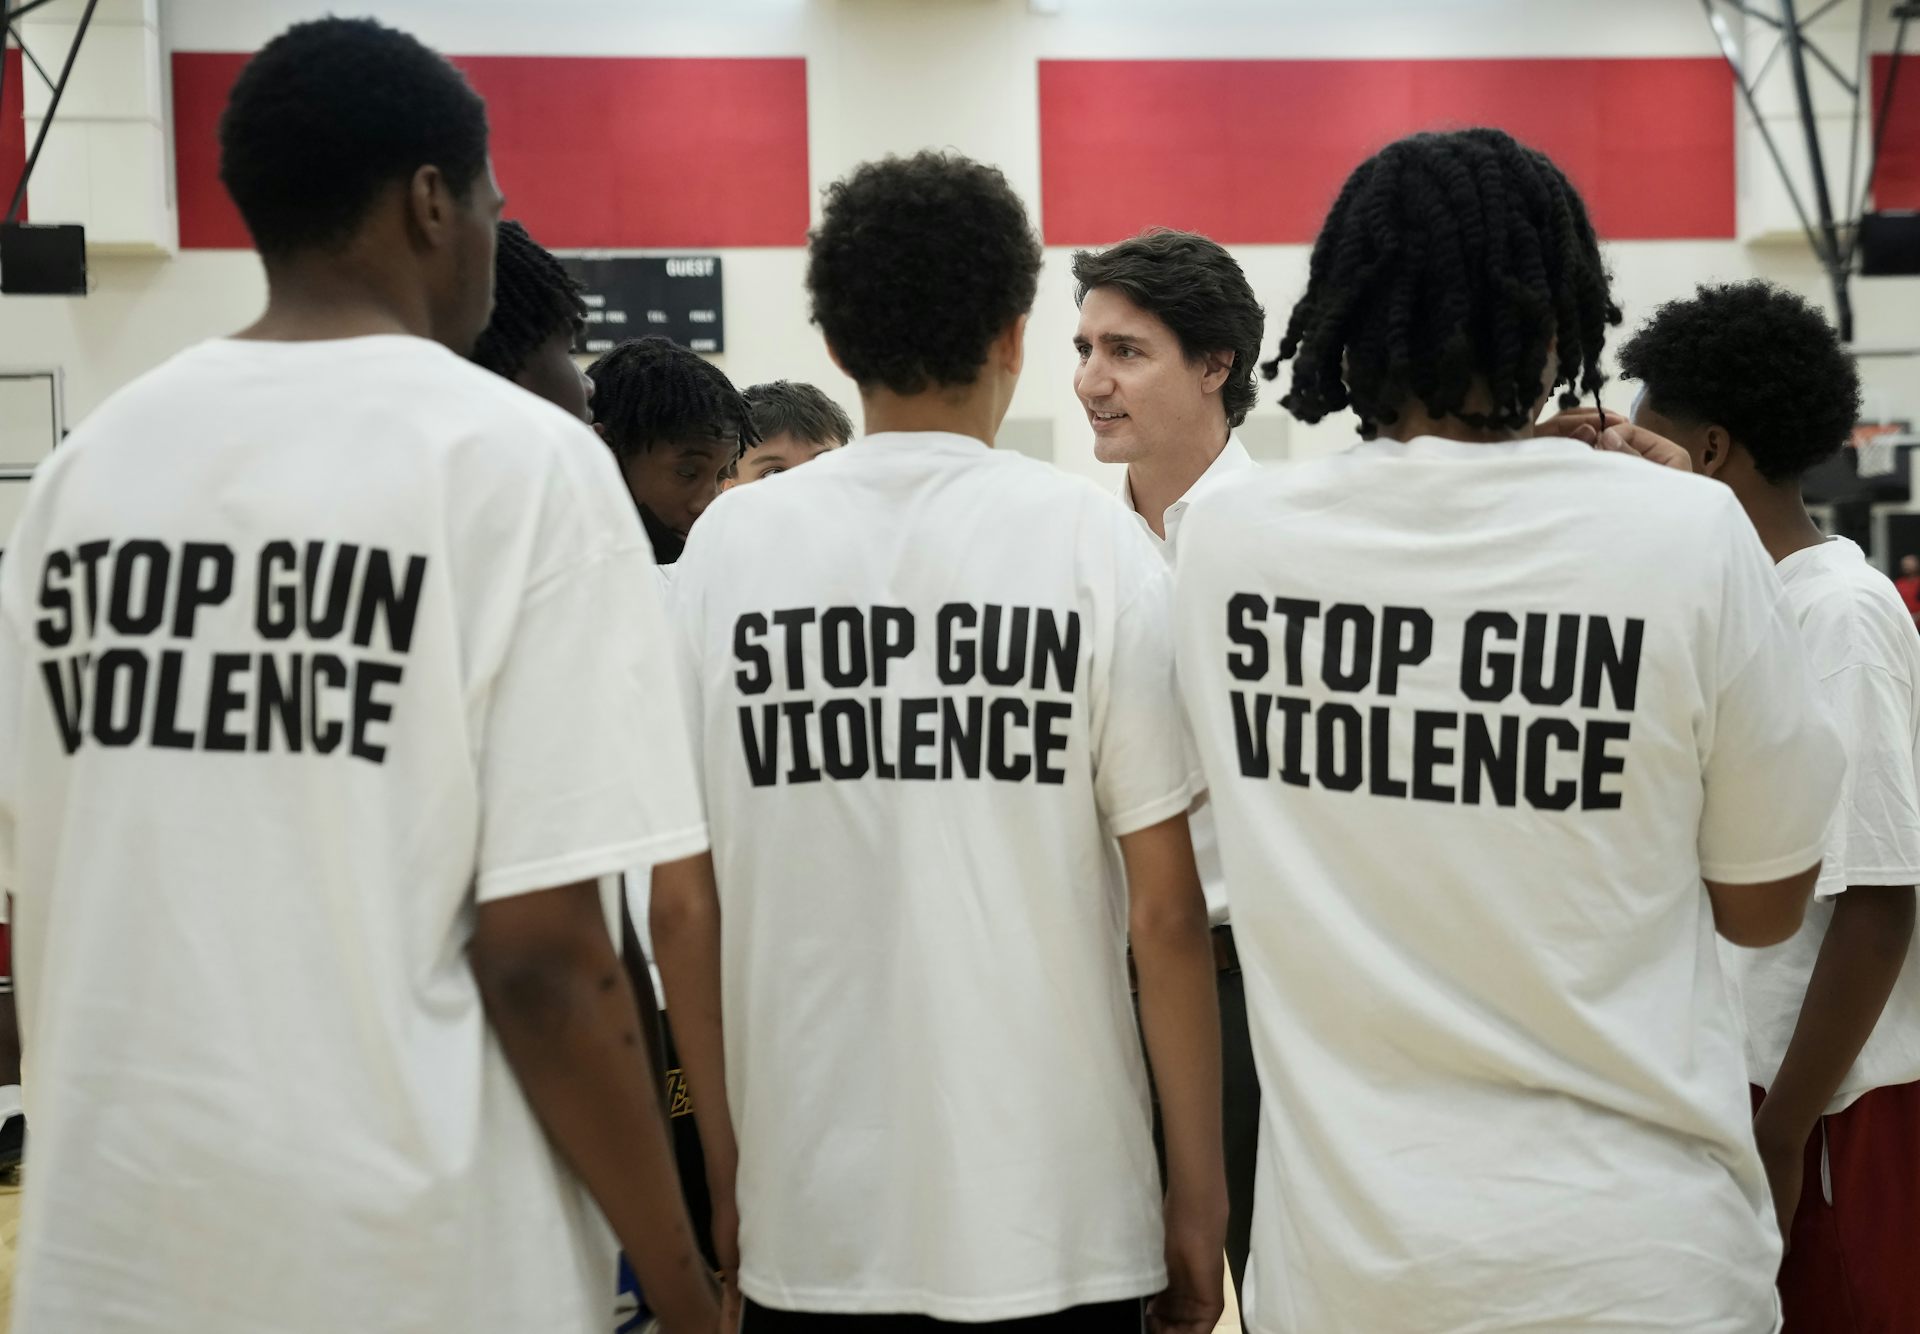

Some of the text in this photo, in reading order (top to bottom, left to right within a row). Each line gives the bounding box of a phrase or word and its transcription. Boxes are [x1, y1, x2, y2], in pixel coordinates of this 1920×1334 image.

[666, 258, 714, 277] GUEST
[36, 539, 427, 654] STOP GUN
[734, 602, 1081, 696] STOP GUN
[1227, 592, 1645, 712] STOP GUN
[41, 648, 403, 764] VOLENCE
[738, 696, 1072, 788] VIOLENCE
[1229, 690, 1631, 812] VIOLENCE
